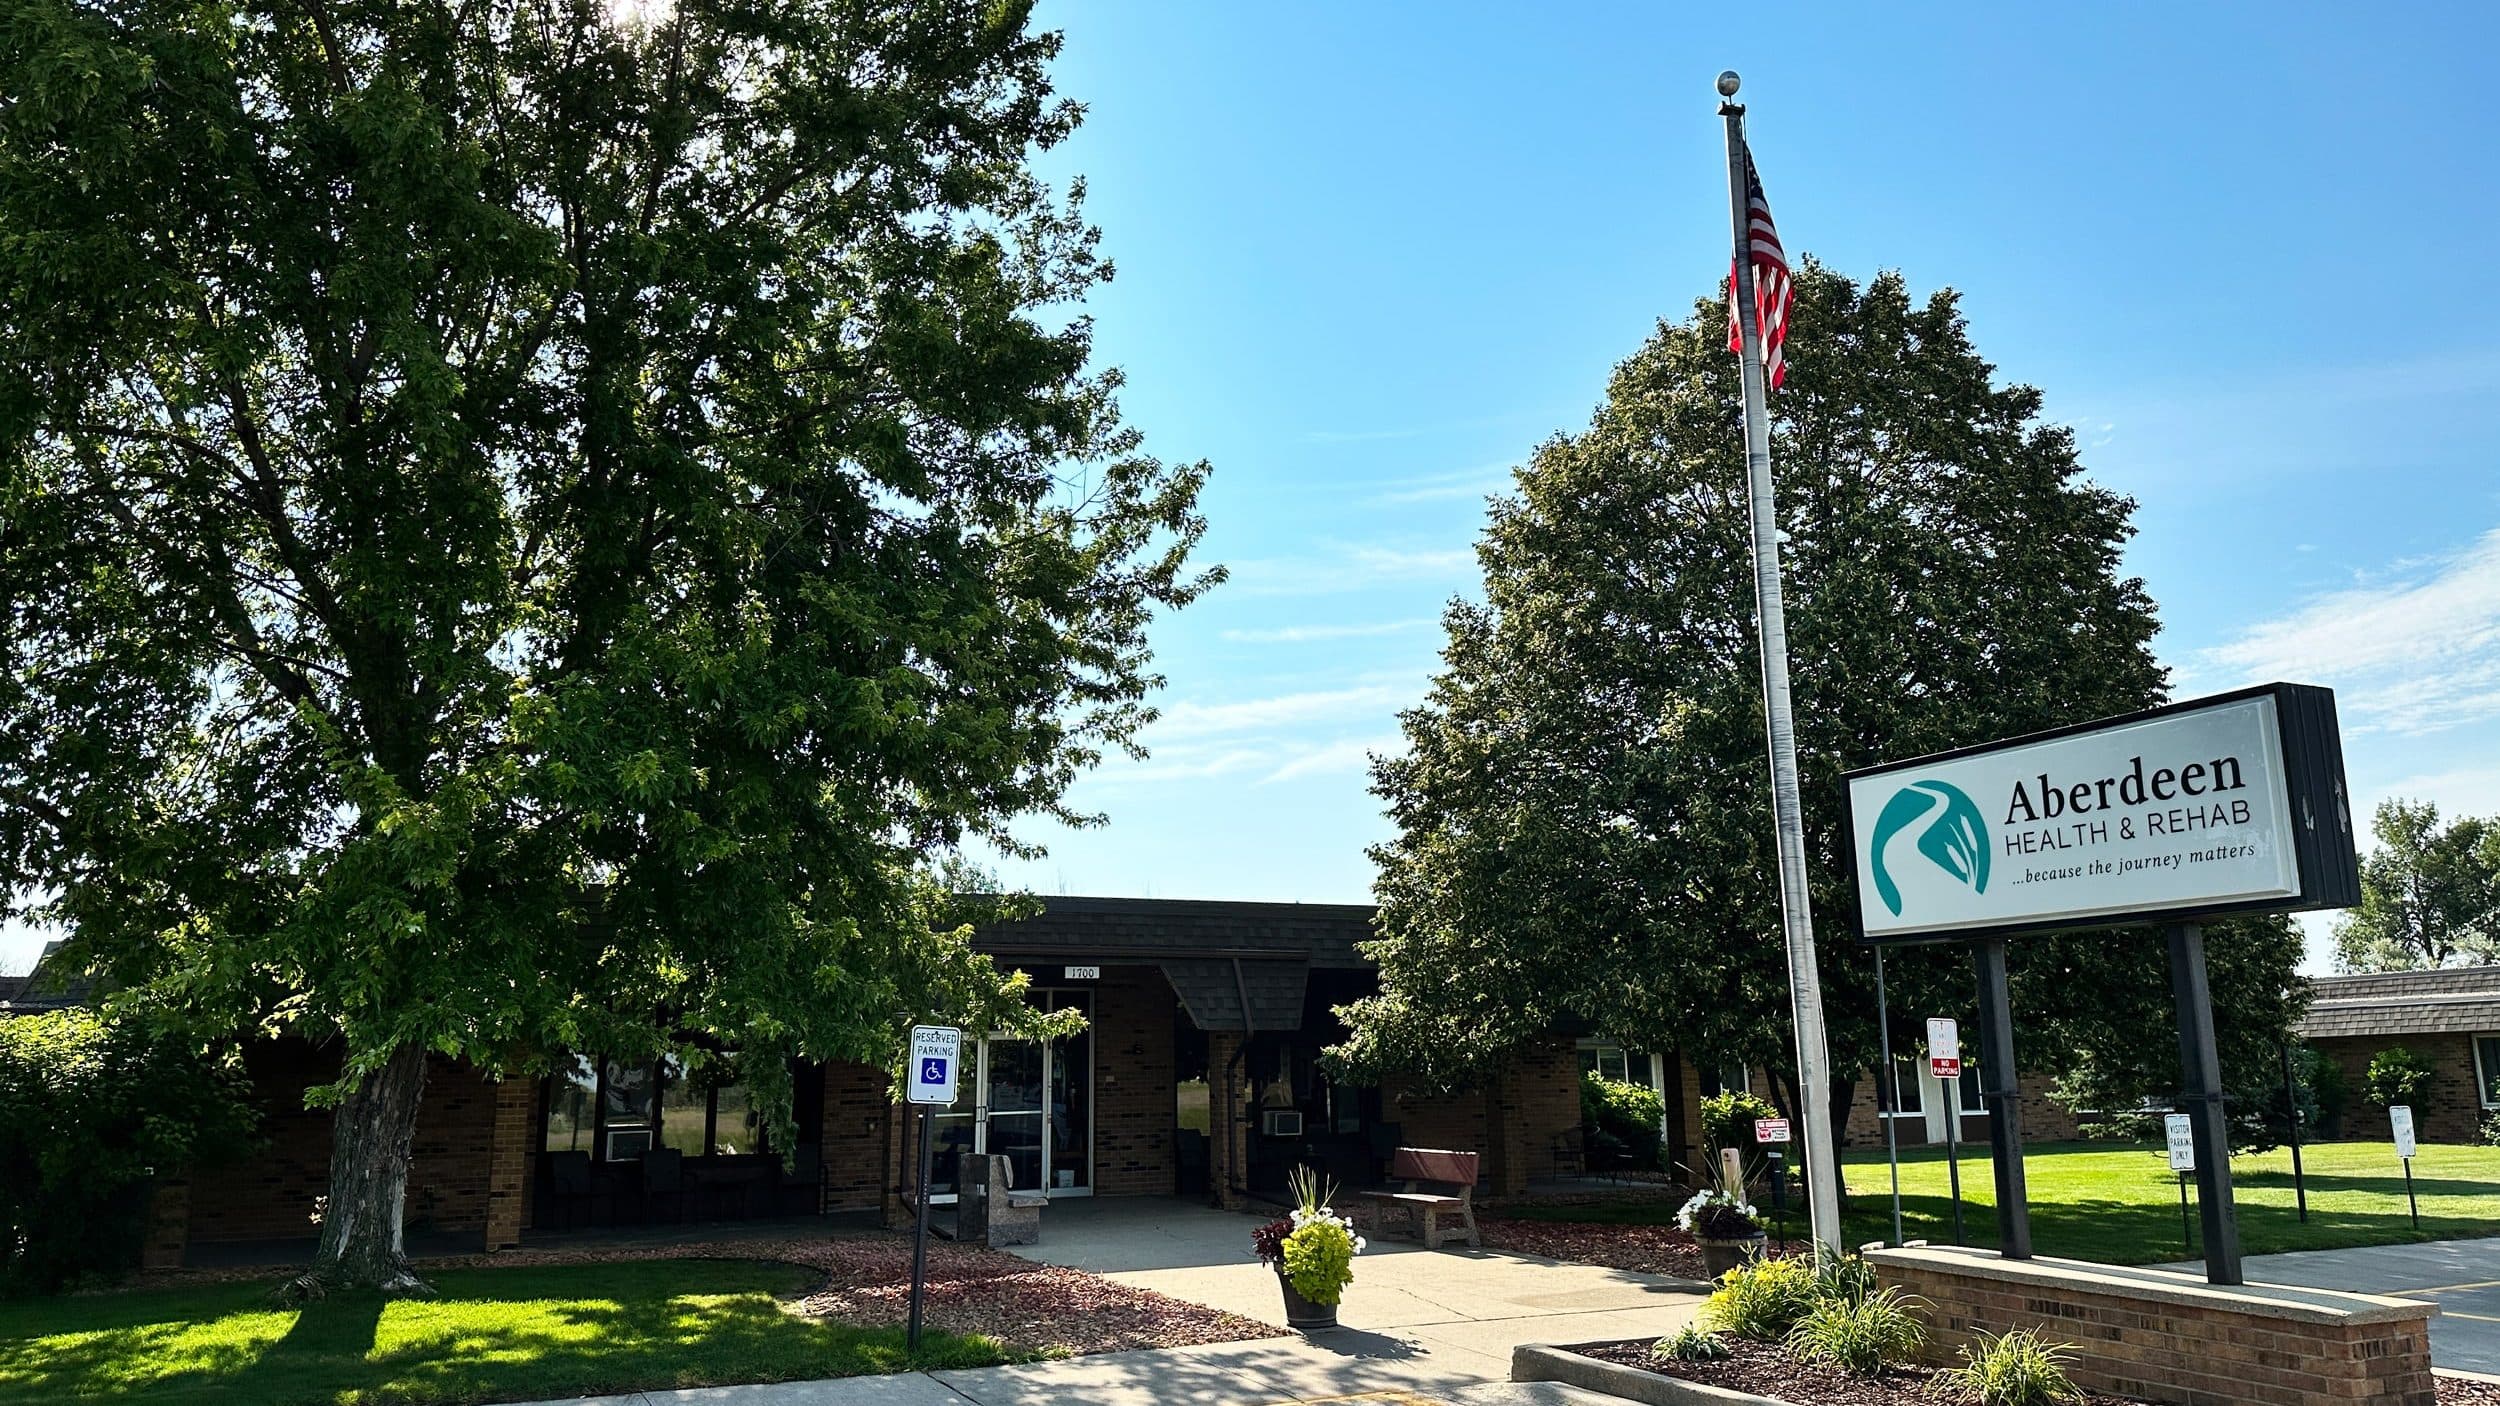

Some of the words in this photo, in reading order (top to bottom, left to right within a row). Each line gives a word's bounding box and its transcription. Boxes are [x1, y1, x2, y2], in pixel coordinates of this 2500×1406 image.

[2004, 755, 2246, 825] Aberdeen
[2005, 820, 2108, 856] HEALTH
[2119, 816, 2136, 840] &
[2147, 799, 2251, 837] REHAB
[2012, 864, 2083, 885] ...because
[2088, 859, 2113, 876] the
[2116, 853, 2182, 876] journey
[2189, 844, 2256, 863] matters
[1072, 967, 1095, 978] 1700
[915, 1031, 957, 1044] RESERVED
[917, 1045, 954, 1057] PARKING
[1933, 1066, 1958, 1075] PARKING
[2170, 1124, 2190, 1134] VISITOR
[2170, 1137, 2192, 1147] PARKING
[2175, 1150, 2188, 1160] ONLY
